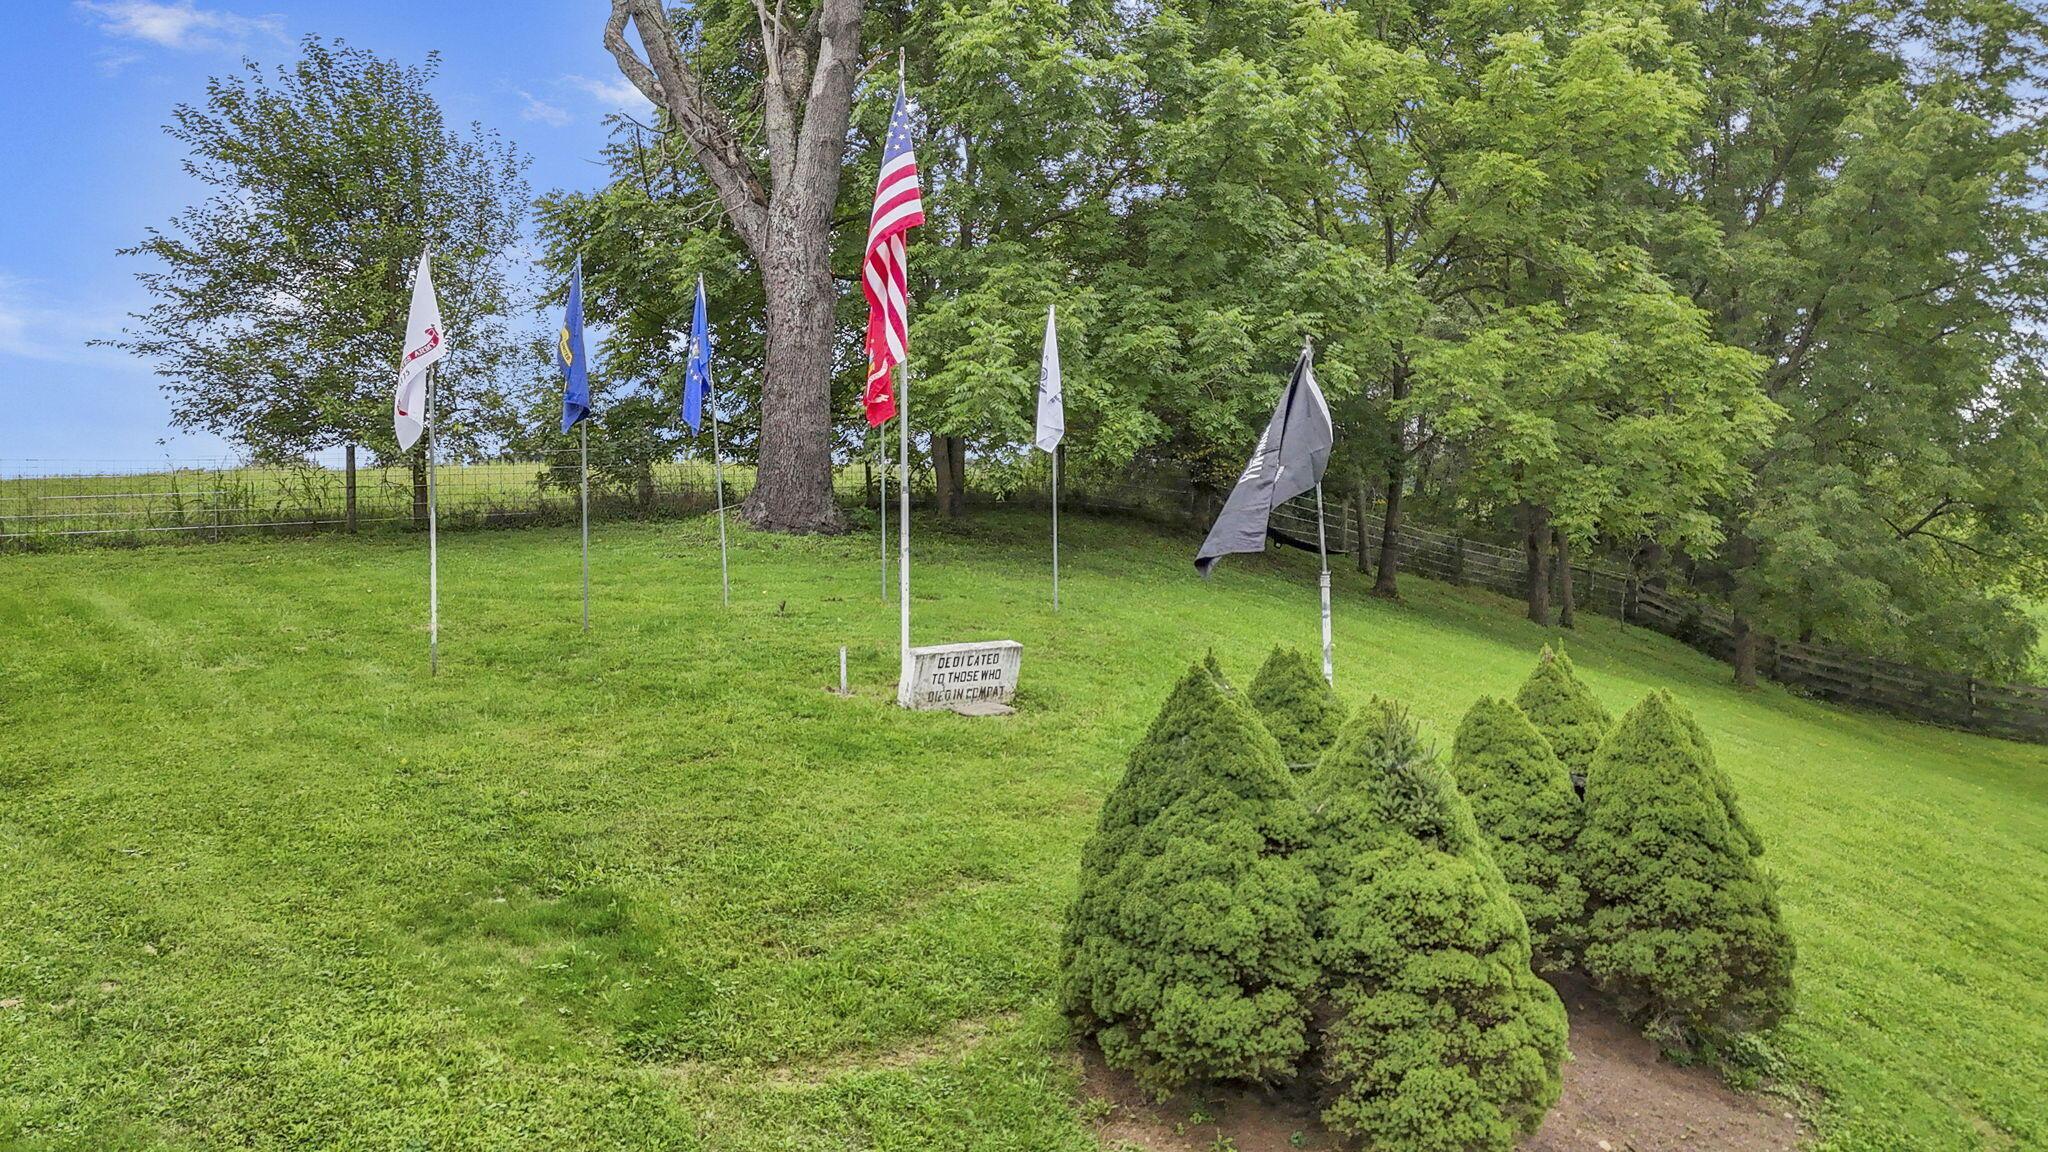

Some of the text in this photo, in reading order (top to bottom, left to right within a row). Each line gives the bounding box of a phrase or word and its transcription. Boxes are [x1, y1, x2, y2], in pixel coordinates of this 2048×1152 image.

[414, 340, 436, 358] ARMY
[938, 653, 999, 669] DEDICATED
[932, 669, 1001, 685] TO THOSE WHO
[953, 689, 963, 700] IN
